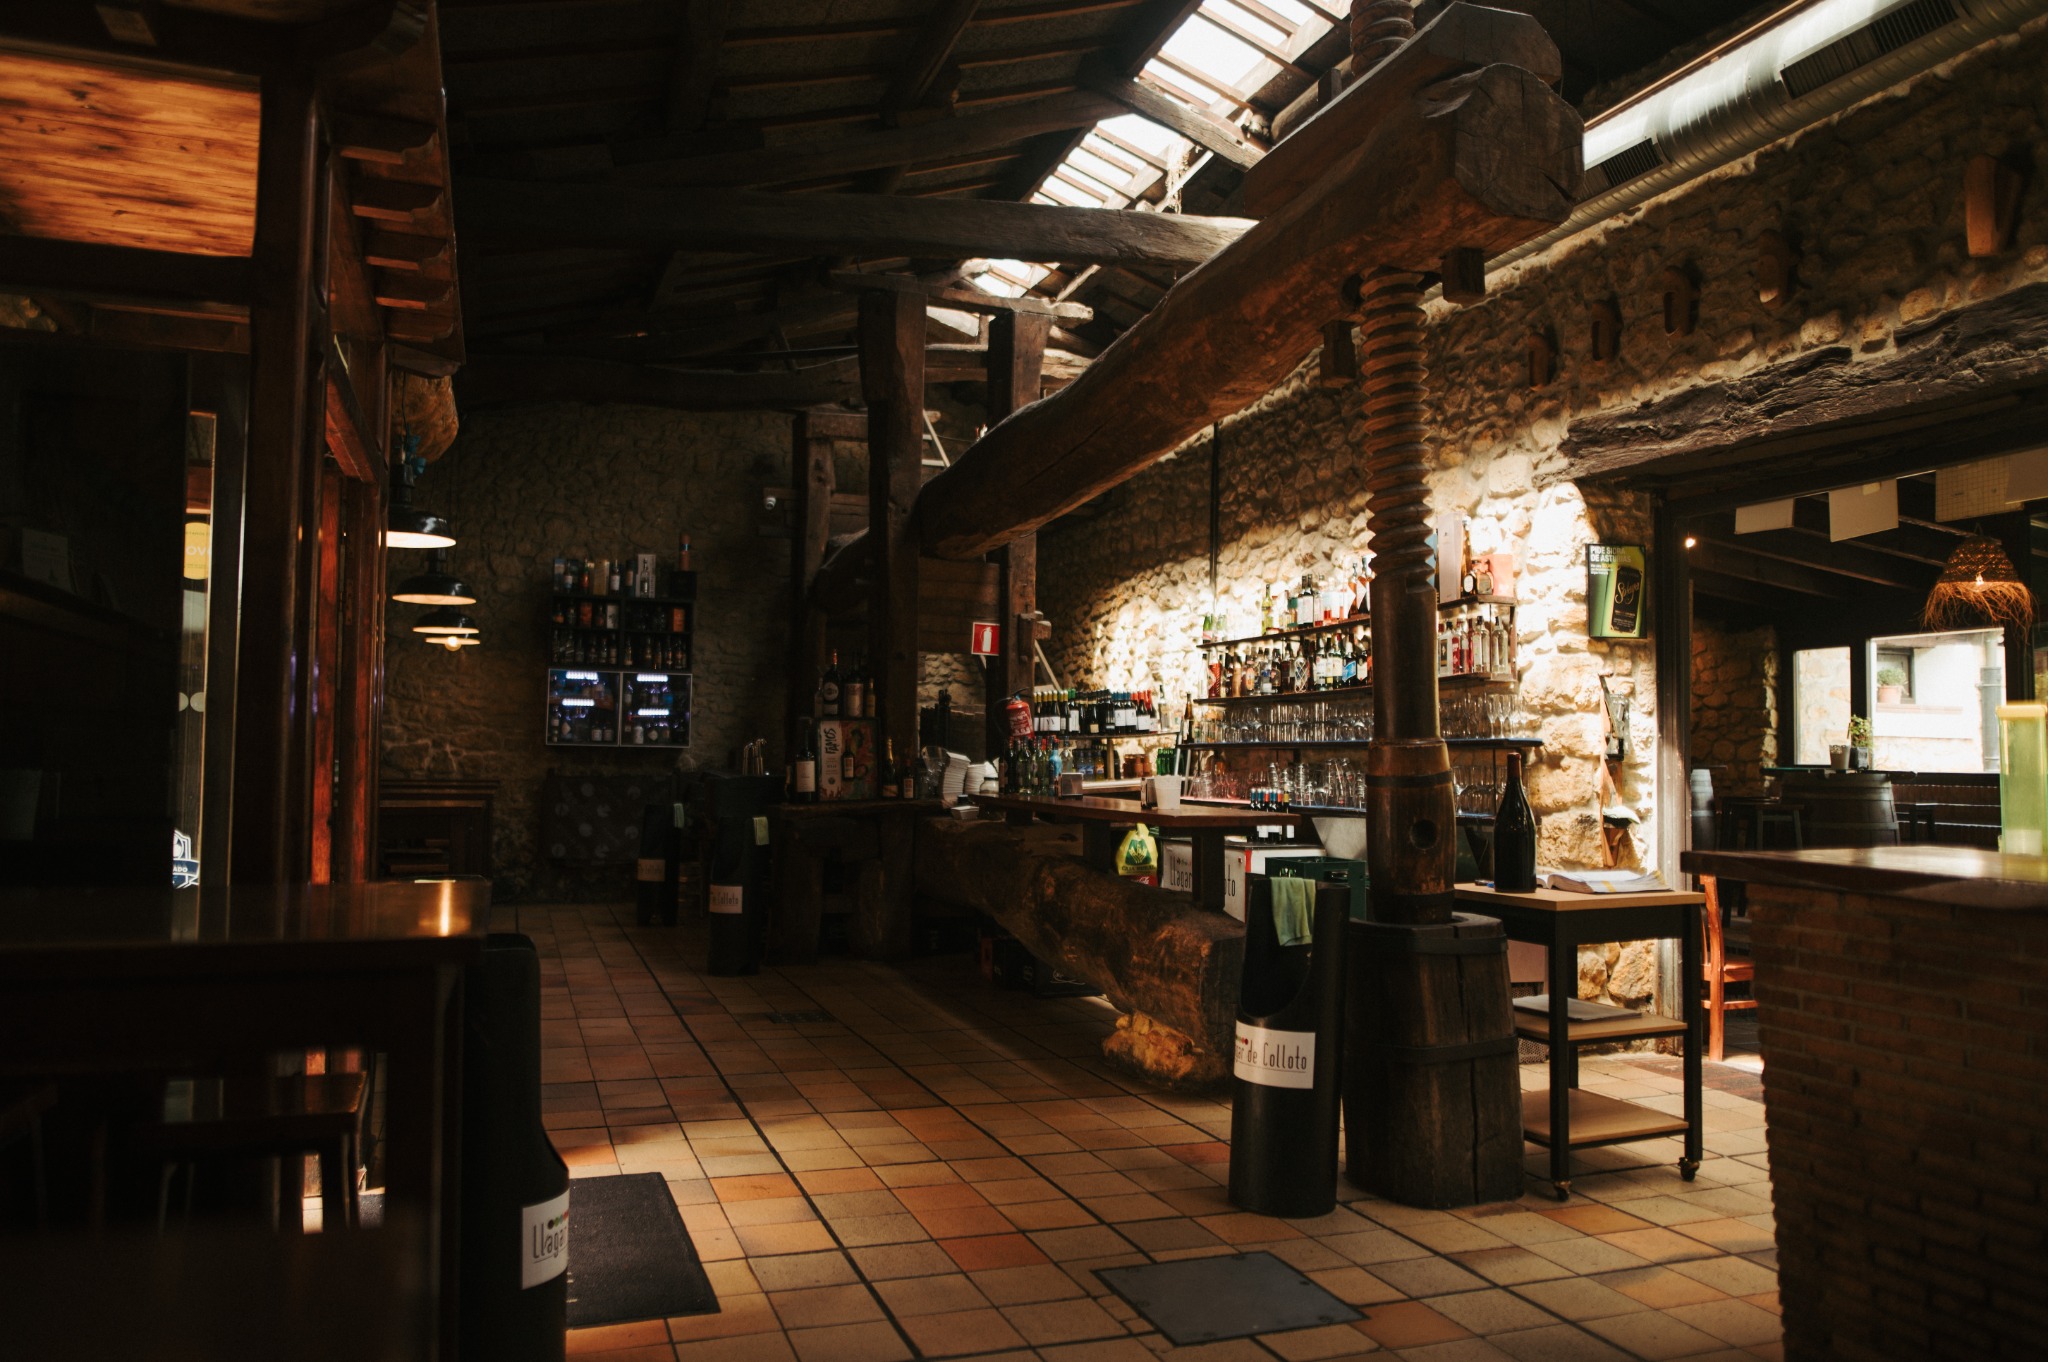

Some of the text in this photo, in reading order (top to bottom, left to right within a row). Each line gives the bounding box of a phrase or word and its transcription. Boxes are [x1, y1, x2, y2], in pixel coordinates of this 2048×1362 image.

[1590, 546, 1605, 554] PIDE
[1590, 554, 1600, 562] DE
[1247, 1040, 1258, 1064] de
[1263, 1042, 1307, 1070] Colloto
